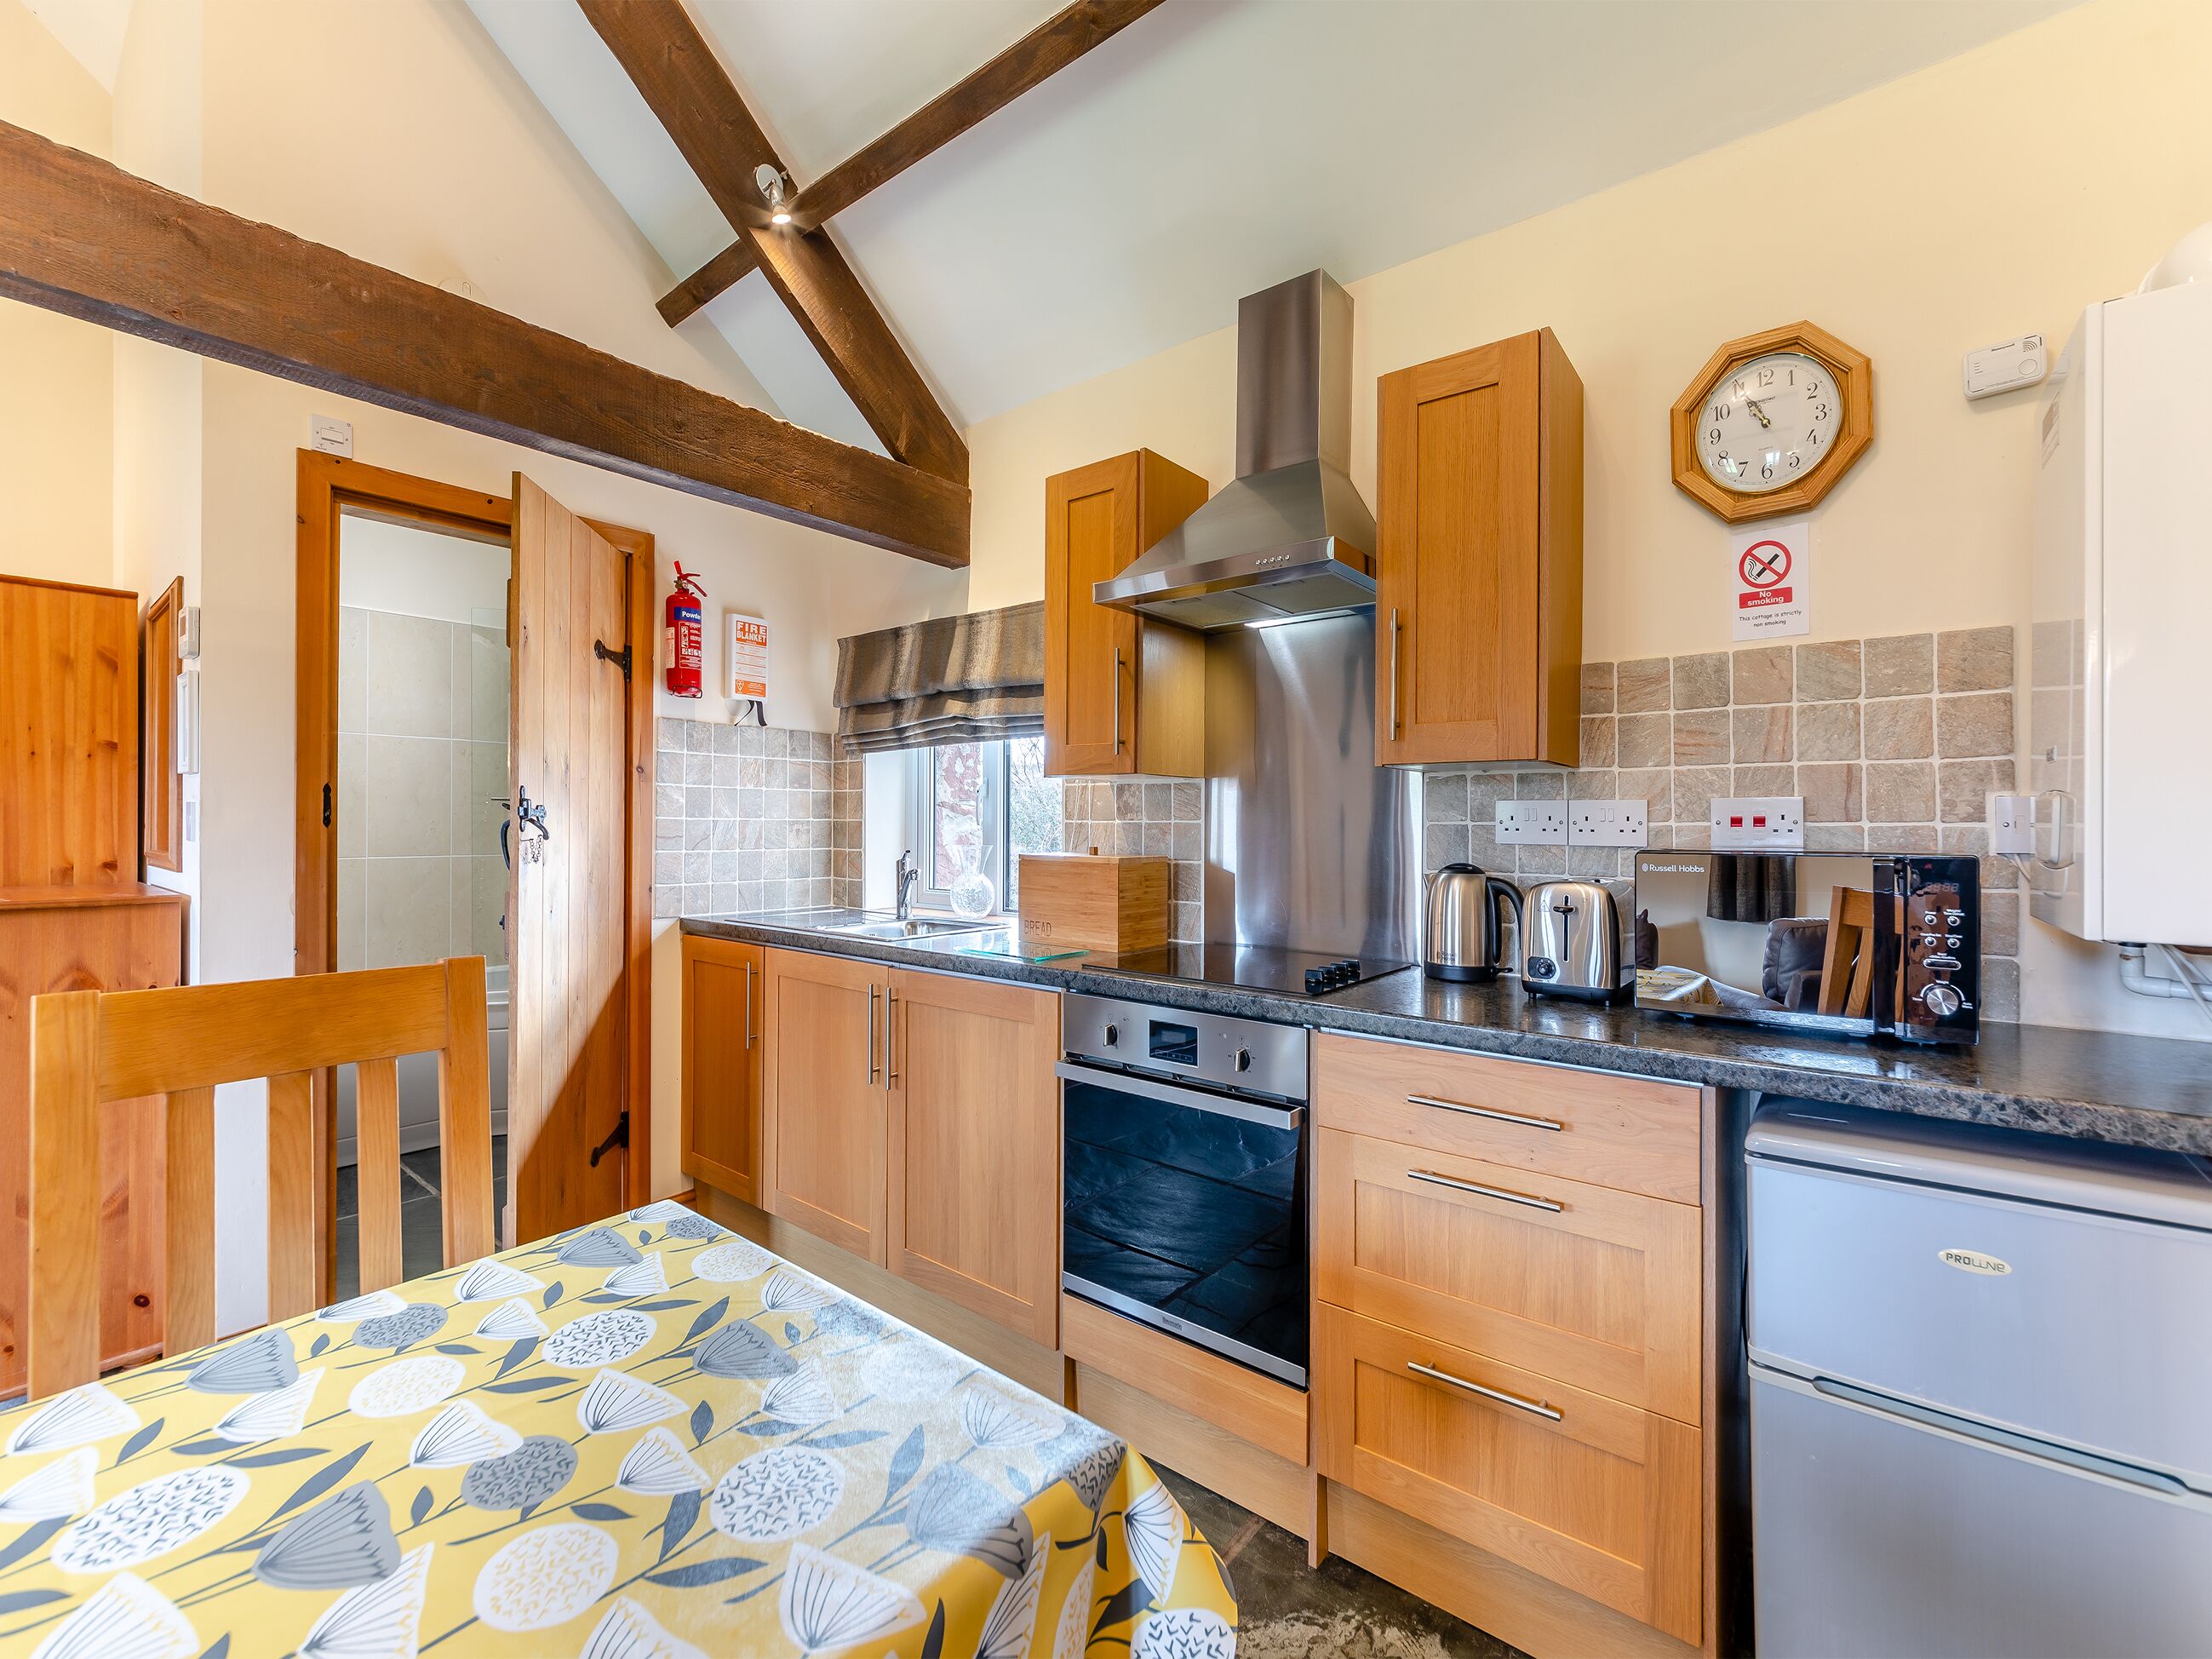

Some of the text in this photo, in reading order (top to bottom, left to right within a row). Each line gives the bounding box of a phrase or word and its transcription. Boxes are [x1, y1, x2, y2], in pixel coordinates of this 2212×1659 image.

[1756, 369, 1774, 387] 12
[1788, 369, 1796, 386] 1
[1807, 382, 1818, 399] 2
[1713, 404, 1730, 422] 10
[1815, 404, 1827, 421] 3
[1710, 428, 1722, 445] 9
[1806, 429, 1817, 445] 4
[1717, 451, 1728, 466] 8
[1789, 452, 1800, 468] 5
[1739, 461, 1749, 477] 7
[1761, 462, 1773, 479] 6
[1747, 596, 1785, 606] smoking
[736, 621, 766, 635] FIRE
[736, 630, 766, 643] BLANKET
[1649, 864, 1705, 873] Russell Hobbs
[1023, 920, 1052, 938] BREAD
